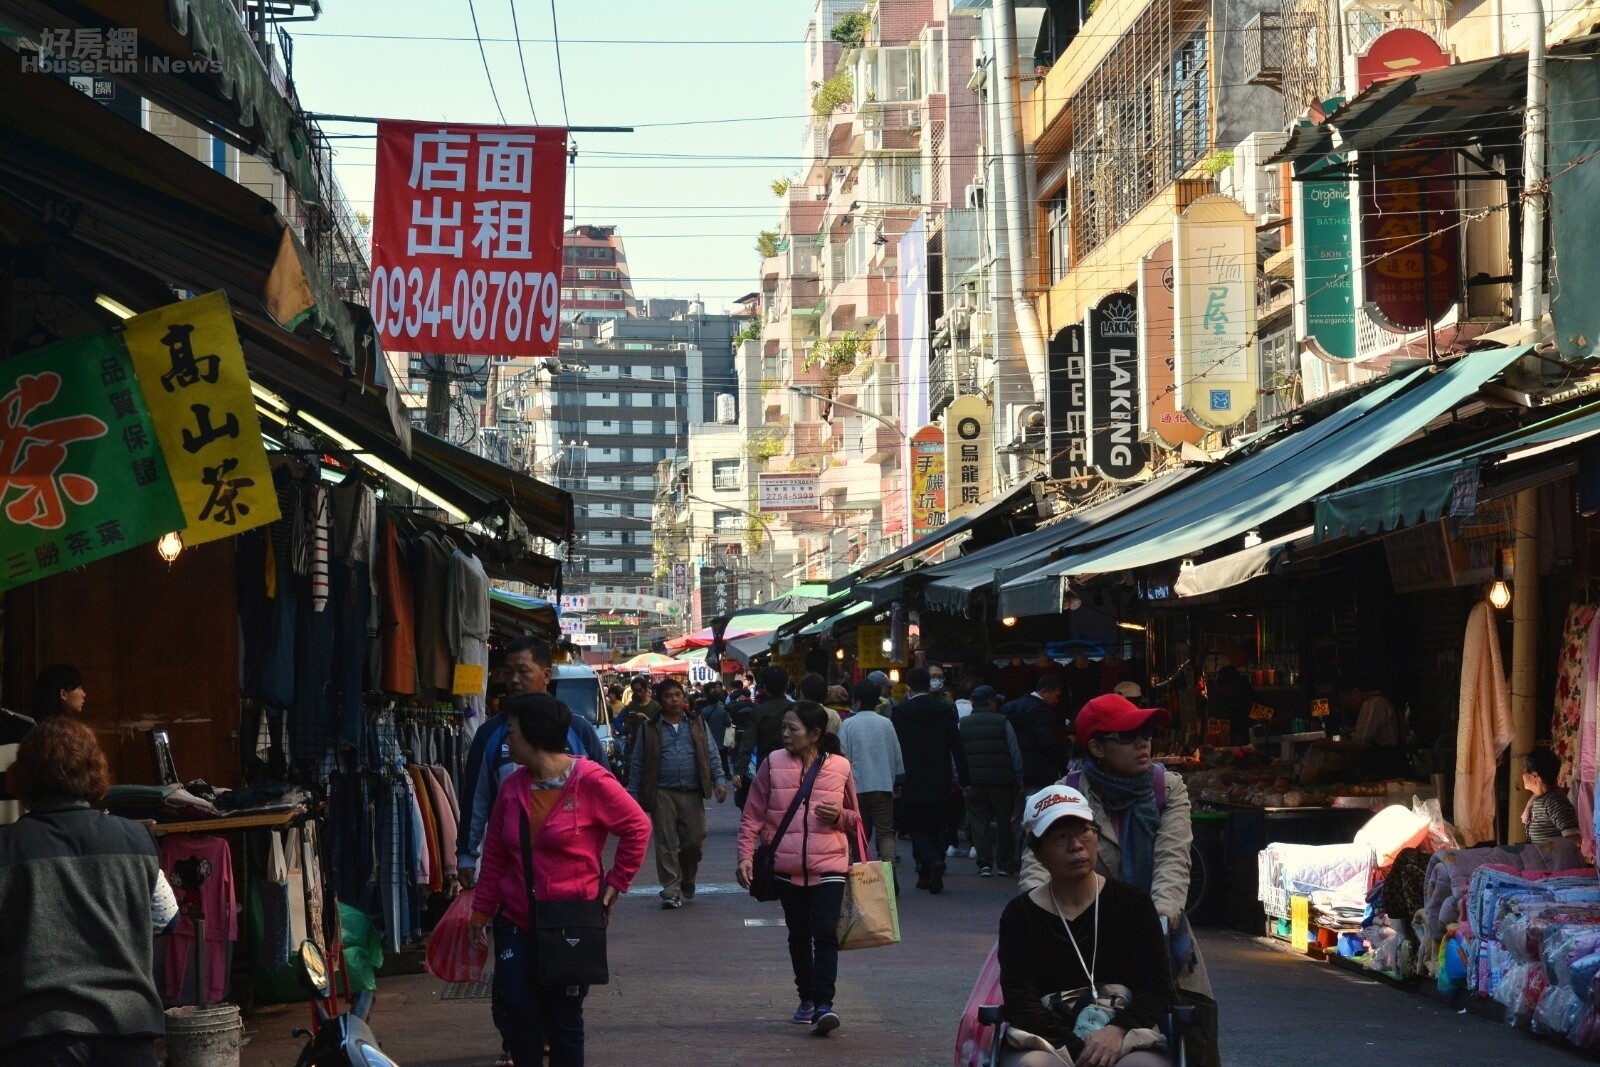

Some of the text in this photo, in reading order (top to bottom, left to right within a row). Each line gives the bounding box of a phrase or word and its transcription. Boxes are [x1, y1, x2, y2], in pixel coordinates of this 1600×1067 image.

[409, 130, 535, 194] 店面
[407, 197, 532, 260] 出租
[1311, 189, 1349, 208] Organic
[371, 266, 558, 343] 0934-087879
[100, 357, 159, 487] 品質保證
[1110, 348, 1132, 467] LAKING
[961, 444, 980, 504] 烏龍院
[6, 519, 125, 579] 三勝茶葉
